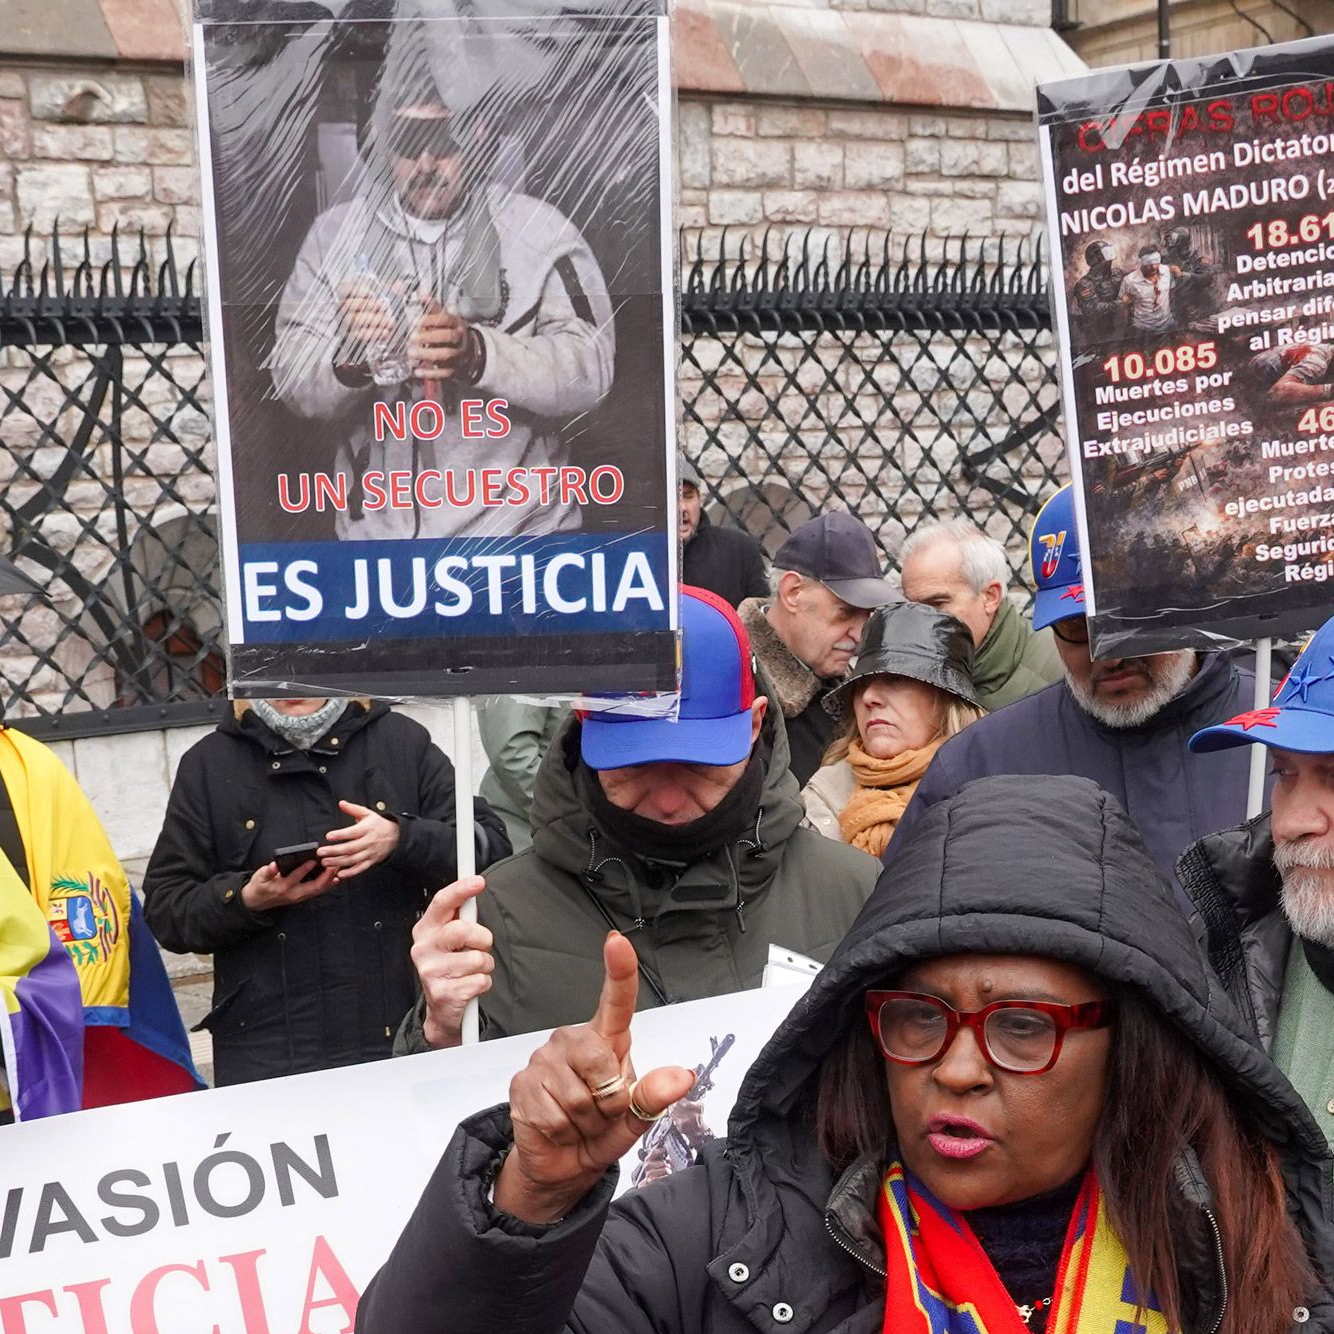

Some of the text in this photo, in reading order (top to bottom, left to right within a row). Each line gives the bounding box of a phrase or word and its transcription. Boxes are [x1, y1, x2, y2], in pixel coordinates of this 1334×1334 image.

[1063, 165, 1103, 194] del
[1111, 151, 1225, 187] Régimen
[1061, 195, 1175, 236] NICOLAS
[1183, 175, 1309, 217] MADURO
[1218, 304, 1297, 333] pensar
[1250, 331, 1271, 351] al
[1103, 342, 1217, 384] 10.085
[1095, 369, 1232, 405] Muertes por
[374, 398, 511, 442] NO ES
[1097, 396, 1236, 431] Ejecuciones
[1083, 420, 1253, 459] Extrajudiciales
[277, 464, 624, 513] UN SECUESTRO
[244, 552, 665, 622] ES JUSTICIA
